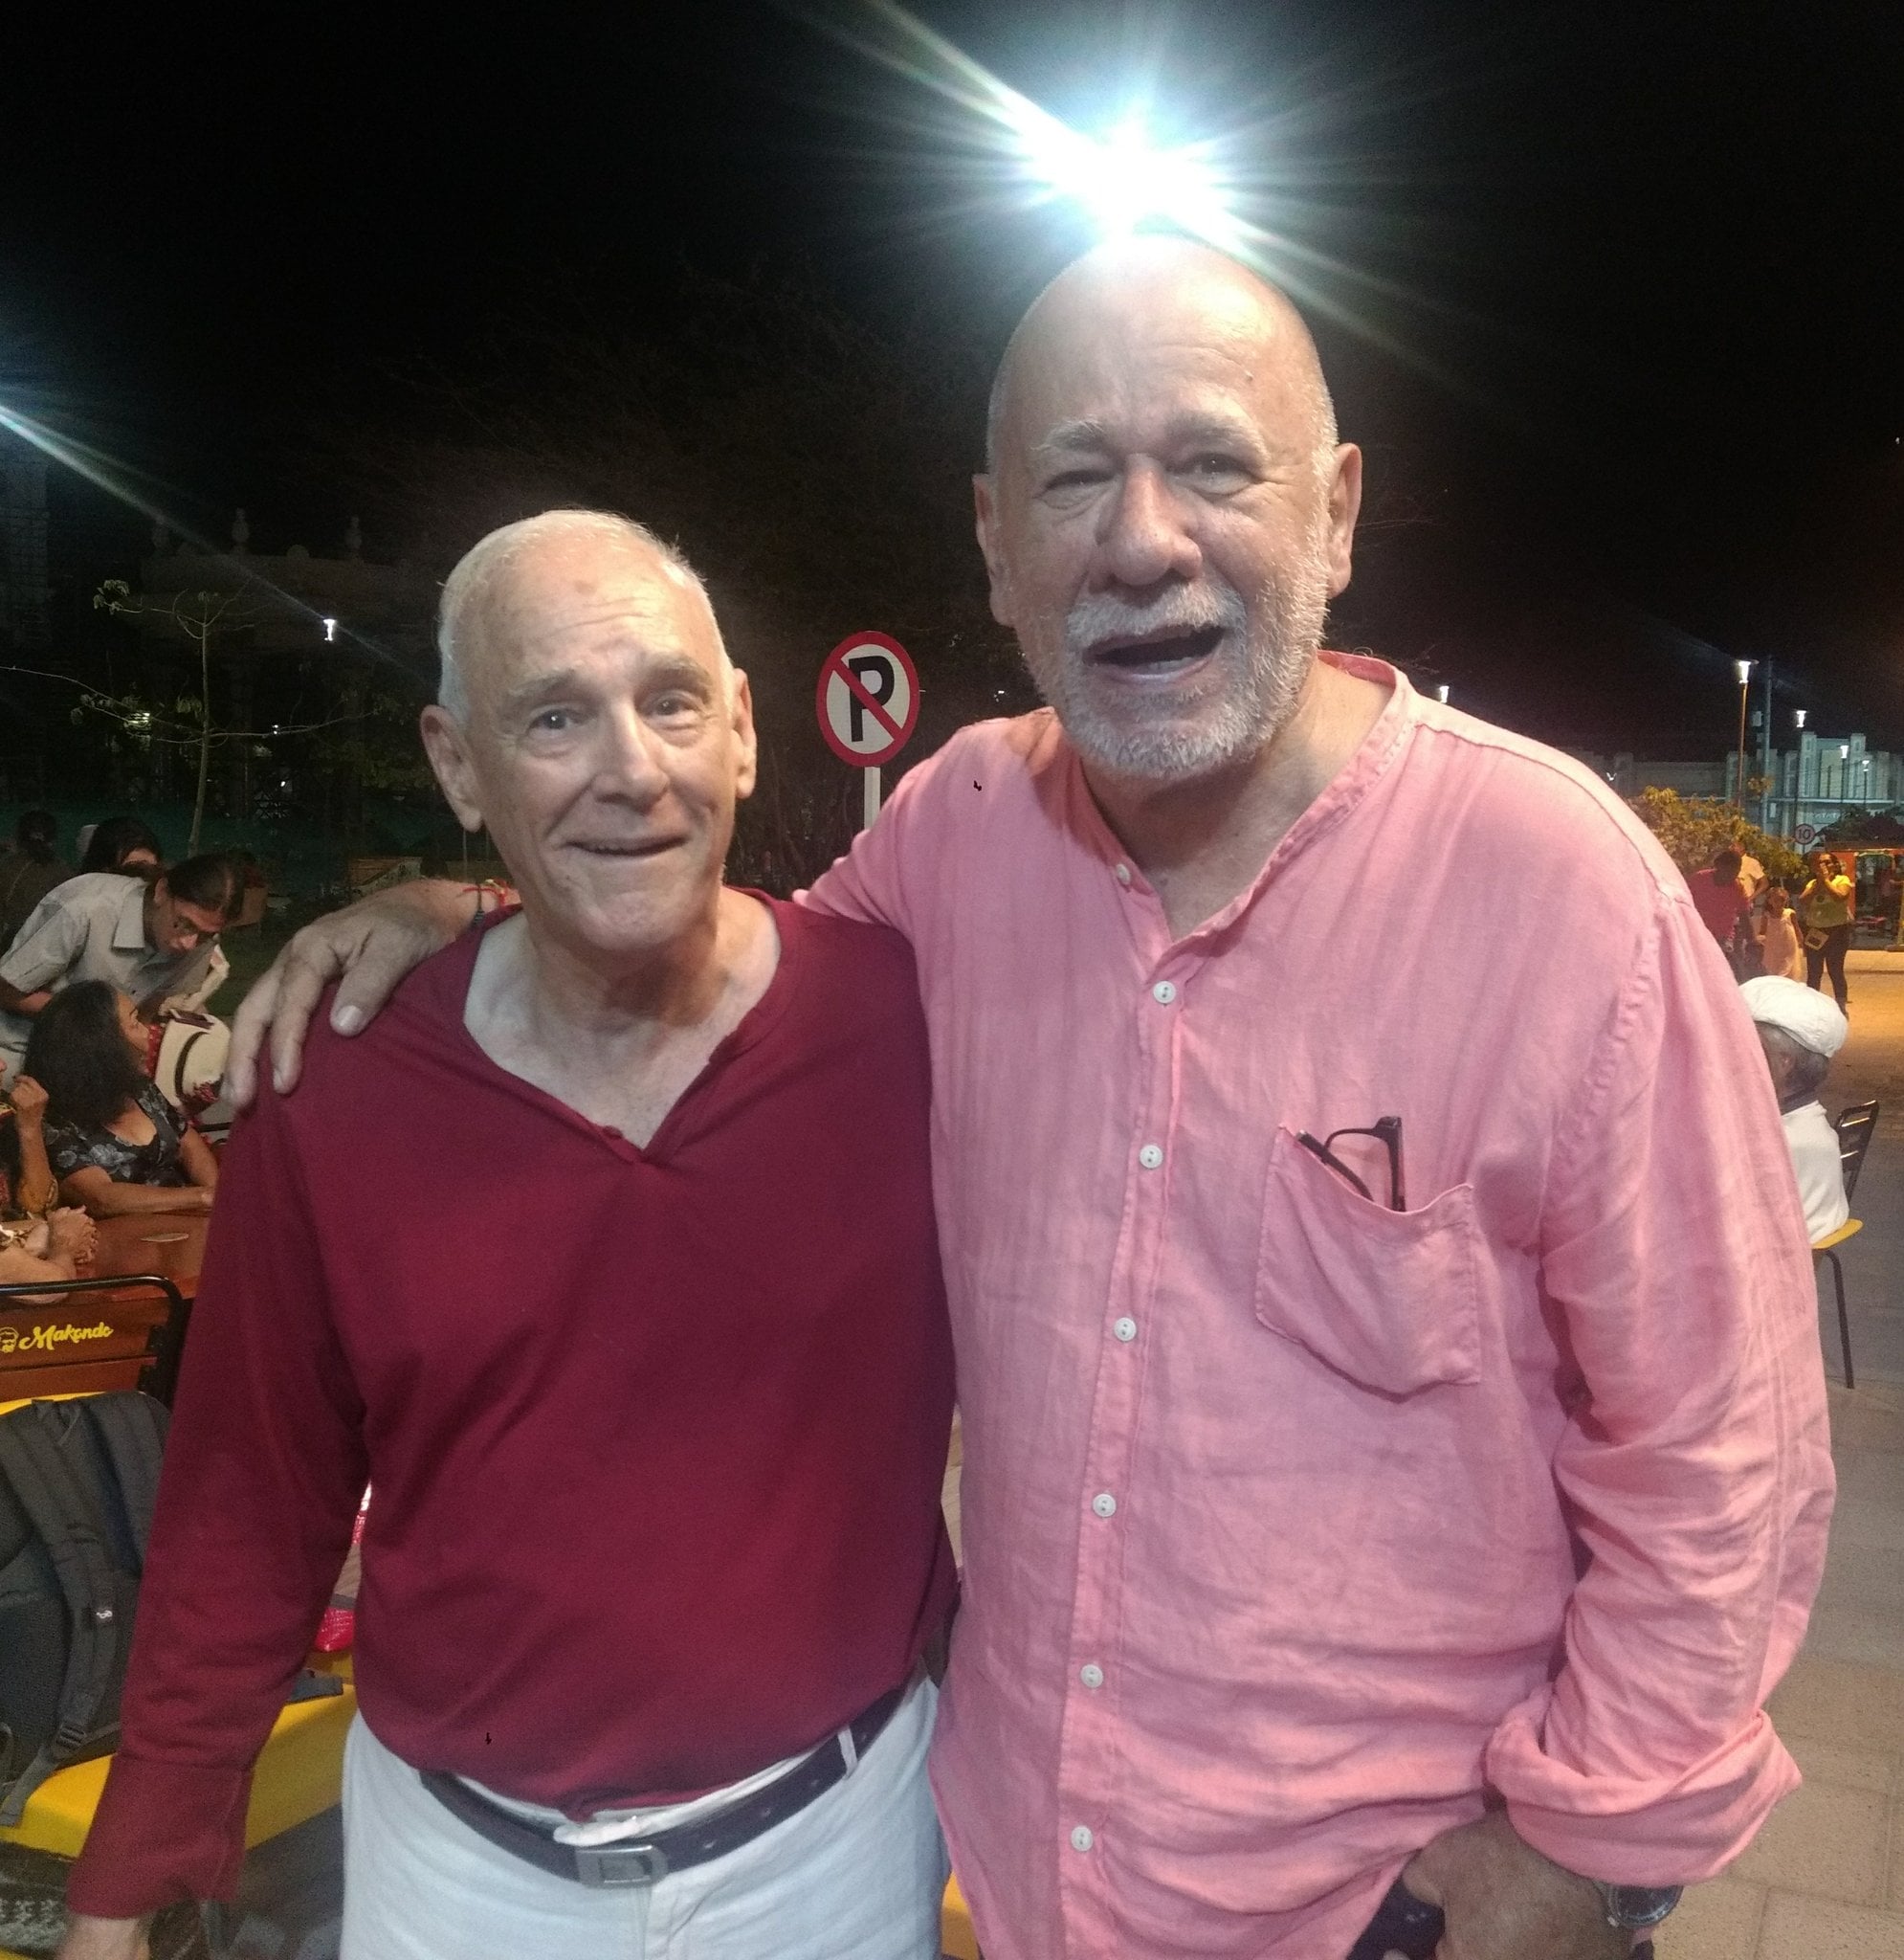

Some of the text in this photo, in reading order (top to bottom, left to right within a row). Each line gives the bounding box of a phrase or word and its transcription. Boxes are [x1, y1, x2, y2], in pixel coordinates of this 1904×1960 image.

[849, 656, 895, 743] P
[1799, 829, 1811, 840] 10
[18, 1322, 114, 1350] Makondo
